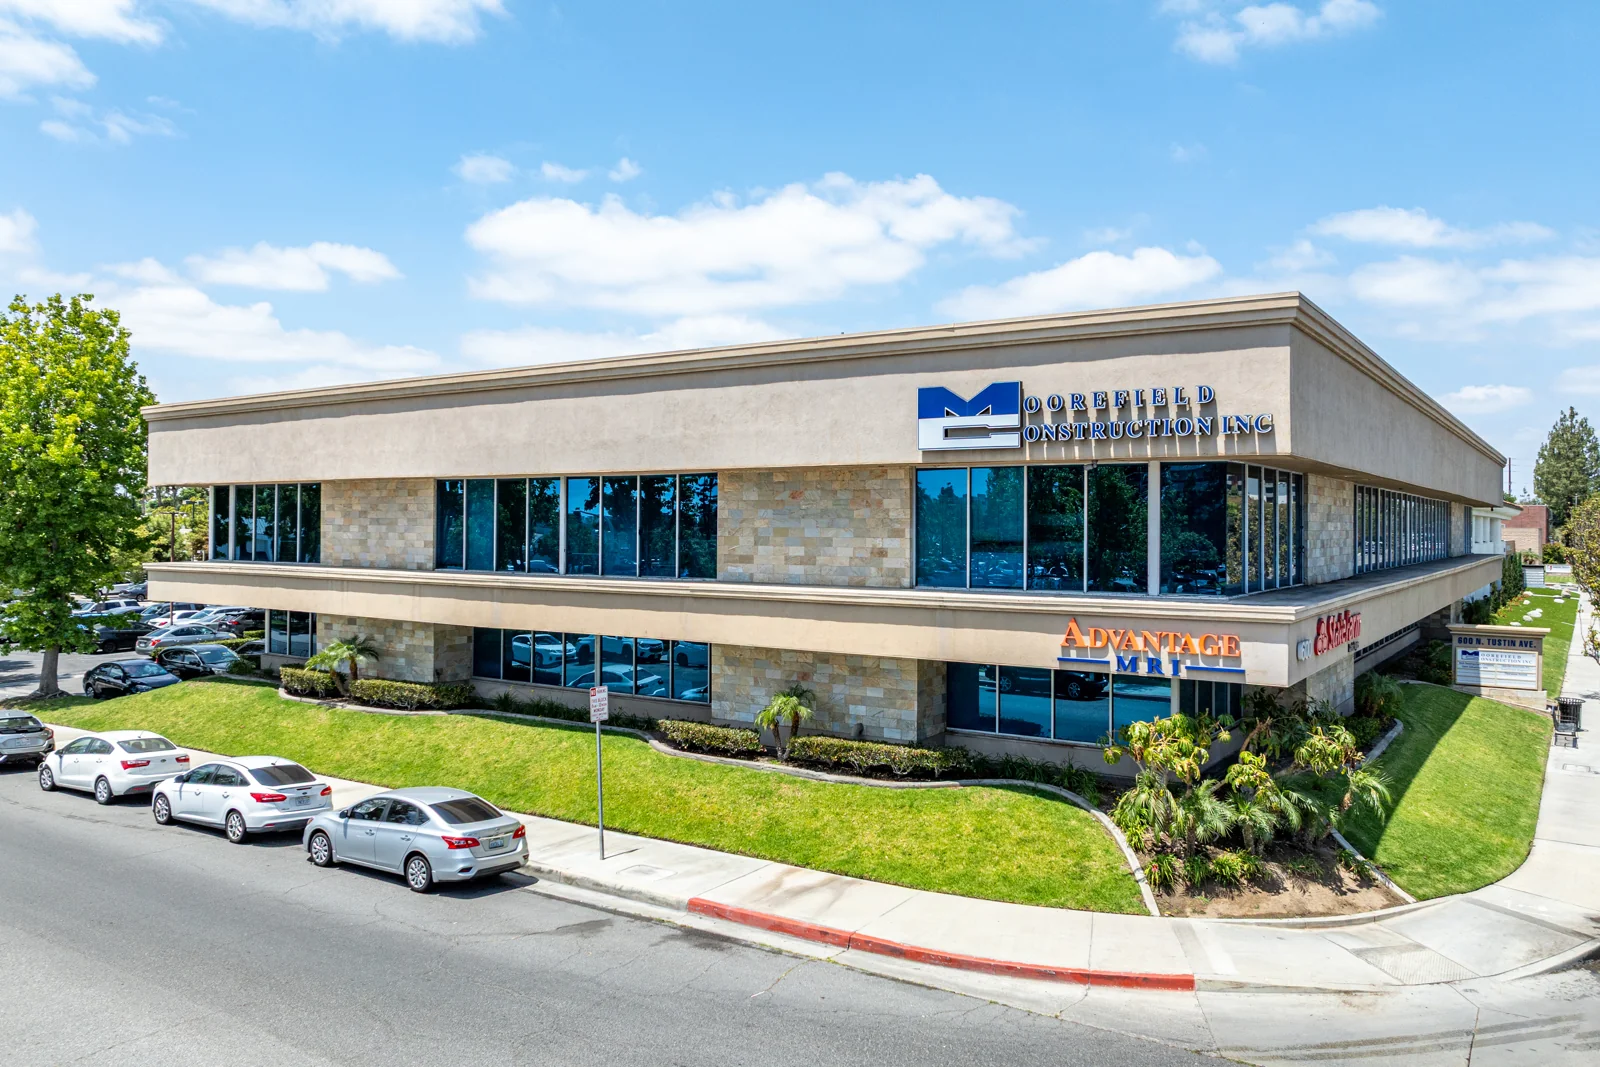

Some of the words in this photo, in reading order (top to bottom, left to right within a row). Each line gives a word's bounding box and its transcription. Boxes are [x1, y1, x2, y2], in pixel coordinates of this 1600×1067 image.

[1220, 413, 1274, 434] INC
[1061, 617, 1241, 657] ADVANTAGE
[1458, 637, 1473, 645] 600
[1487, 639, 1516, 647] TUSTIN
[1116, 655, 1180, 676] MRI
